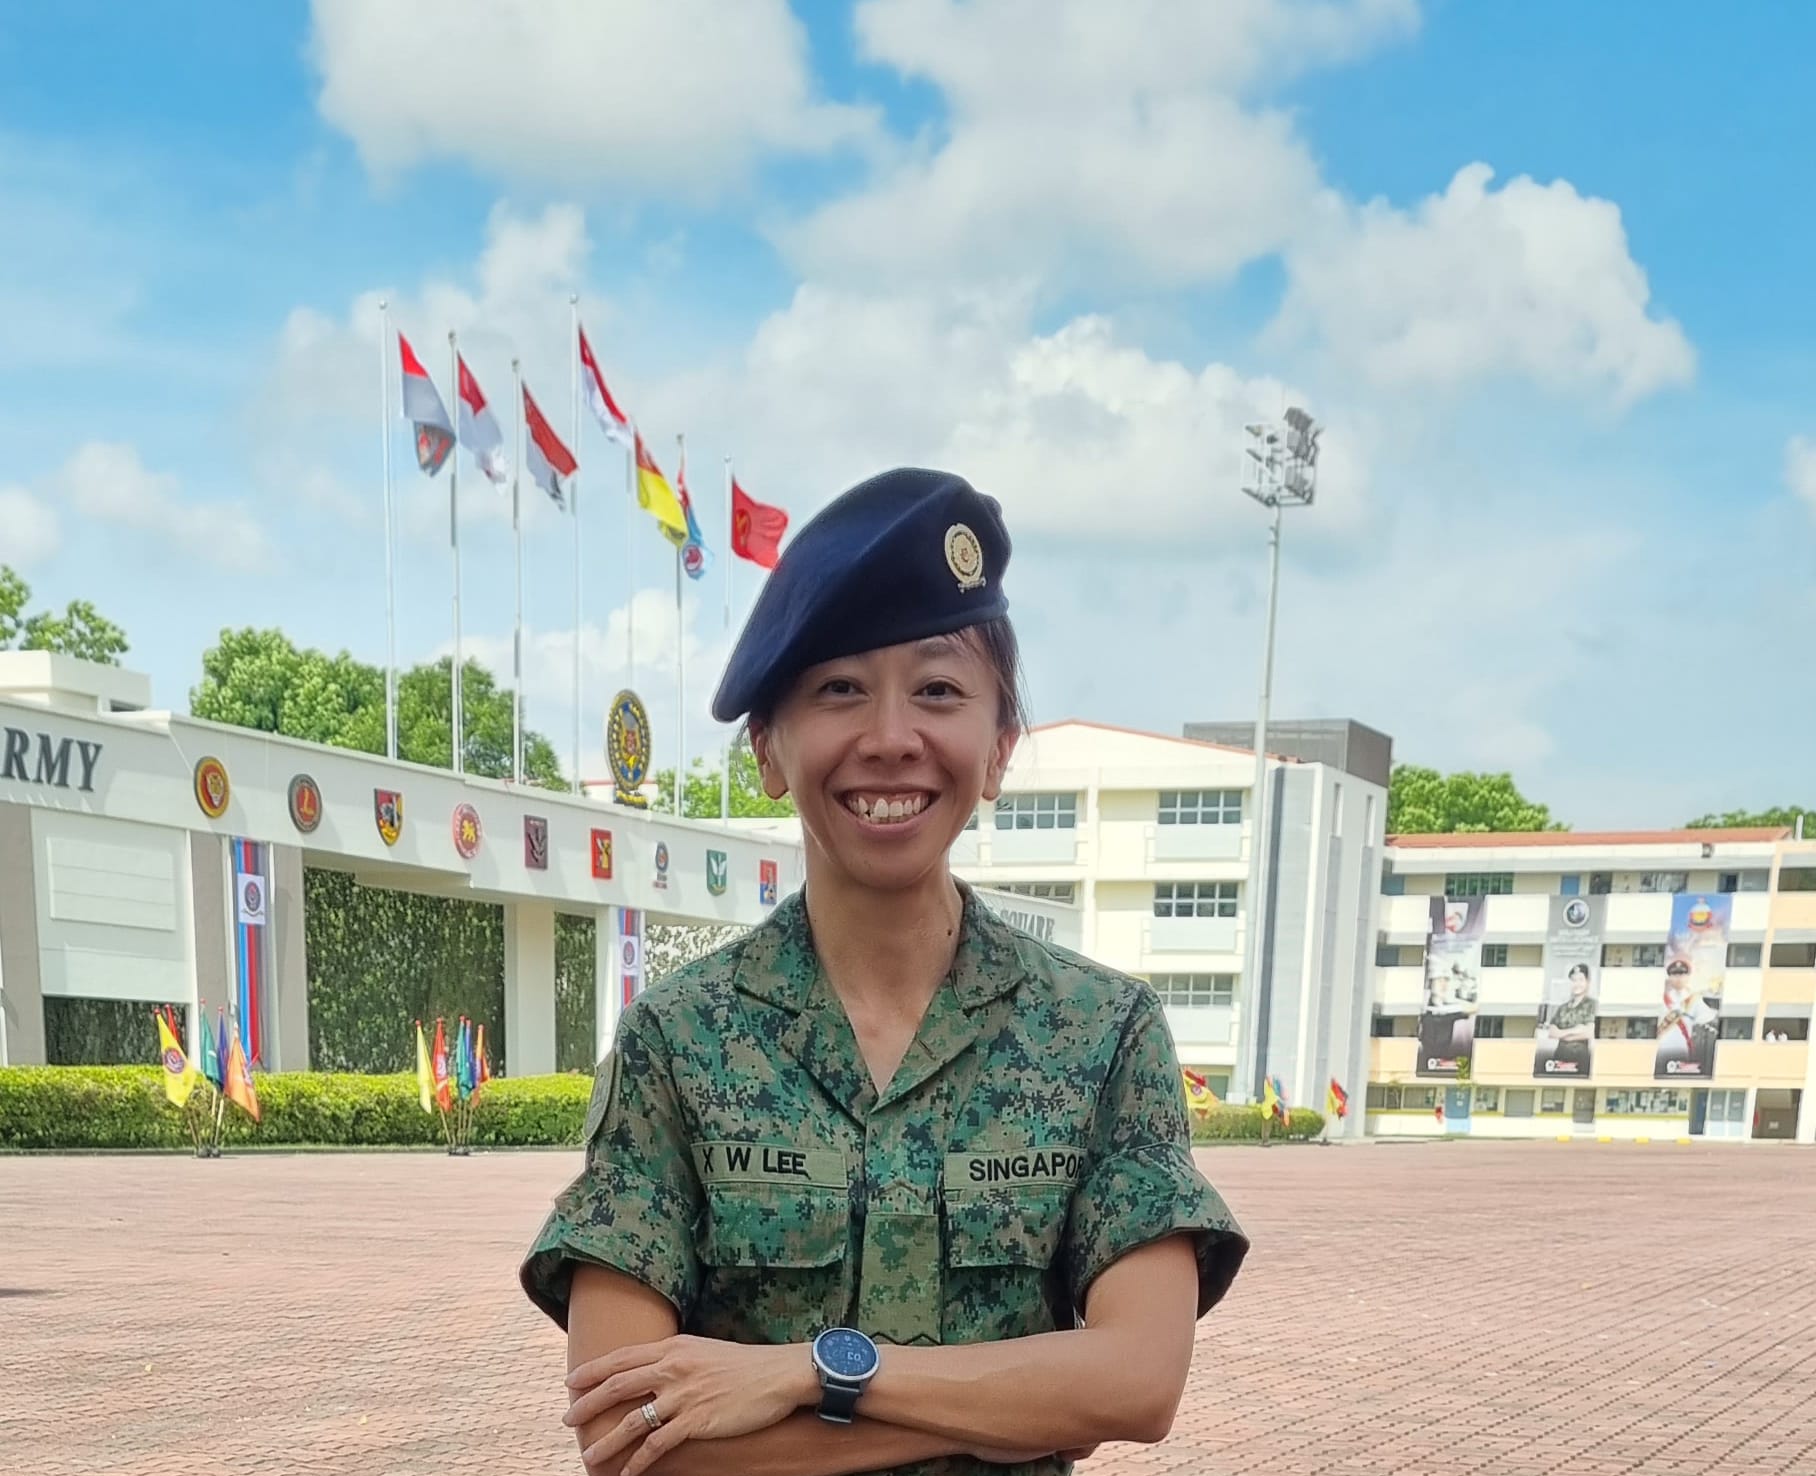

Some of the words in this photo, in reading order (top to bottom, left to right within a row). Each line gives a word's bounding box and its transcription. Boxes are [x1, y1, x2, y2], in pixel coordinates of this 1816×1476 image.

[0, 727, 103, 793] RMY
[726, 1146, 752, 1172] W
[763, 1148, 808, 1176] LEE
